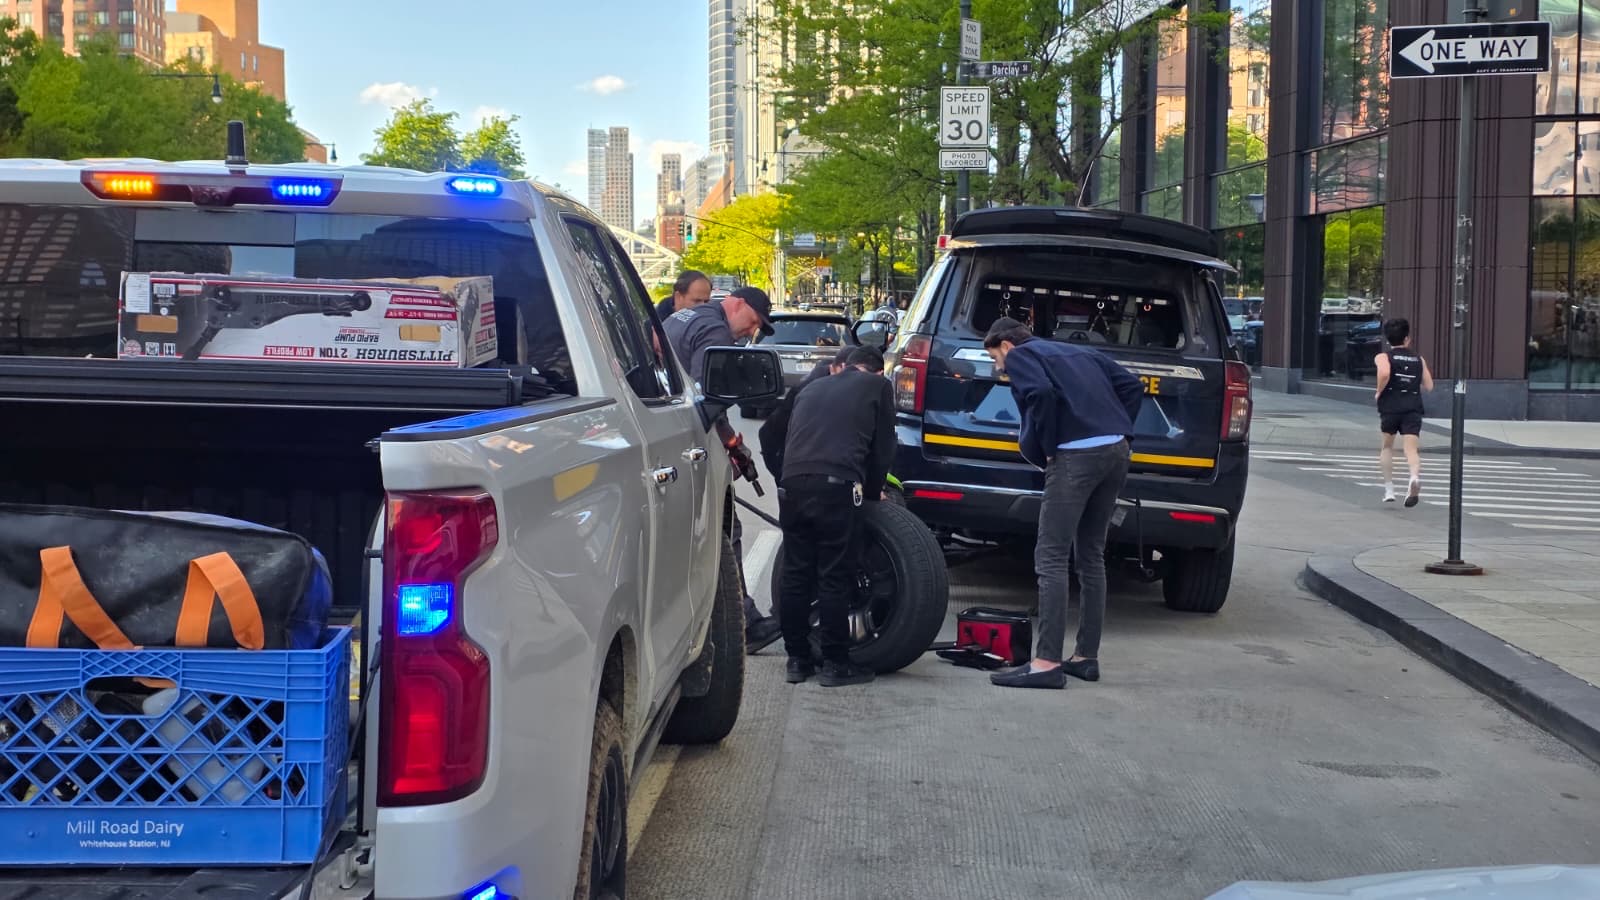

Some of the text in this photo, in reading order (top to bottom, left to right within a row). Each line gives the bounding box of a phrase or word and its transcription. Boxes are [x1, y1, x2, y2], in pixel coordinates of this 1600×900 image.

[966, 23, 977, 32] END
[965, 35, 978, 45] TOLL
[965, 47, 978, 57] ZONE
[1420, 38, 1527, 61] ONE WAY
[992, 65, 1020, 76] Barclay
[946, 93, 985, 103] SPEED
[950, 105, 981, 115] LIMIT
[947, 119, 983, 141] 30
[334, 333, 379, 343] RAPID PUMP
[266, 346, 294, 356] PROFILE
[296, 347, 312, 356] LOW
[355, 349, 452, 361] PITTSBURGH
[66, 820, 184, 837] Mill Road Dairy
[79, 839, 171, 848] Whitehouse Station, NJ
